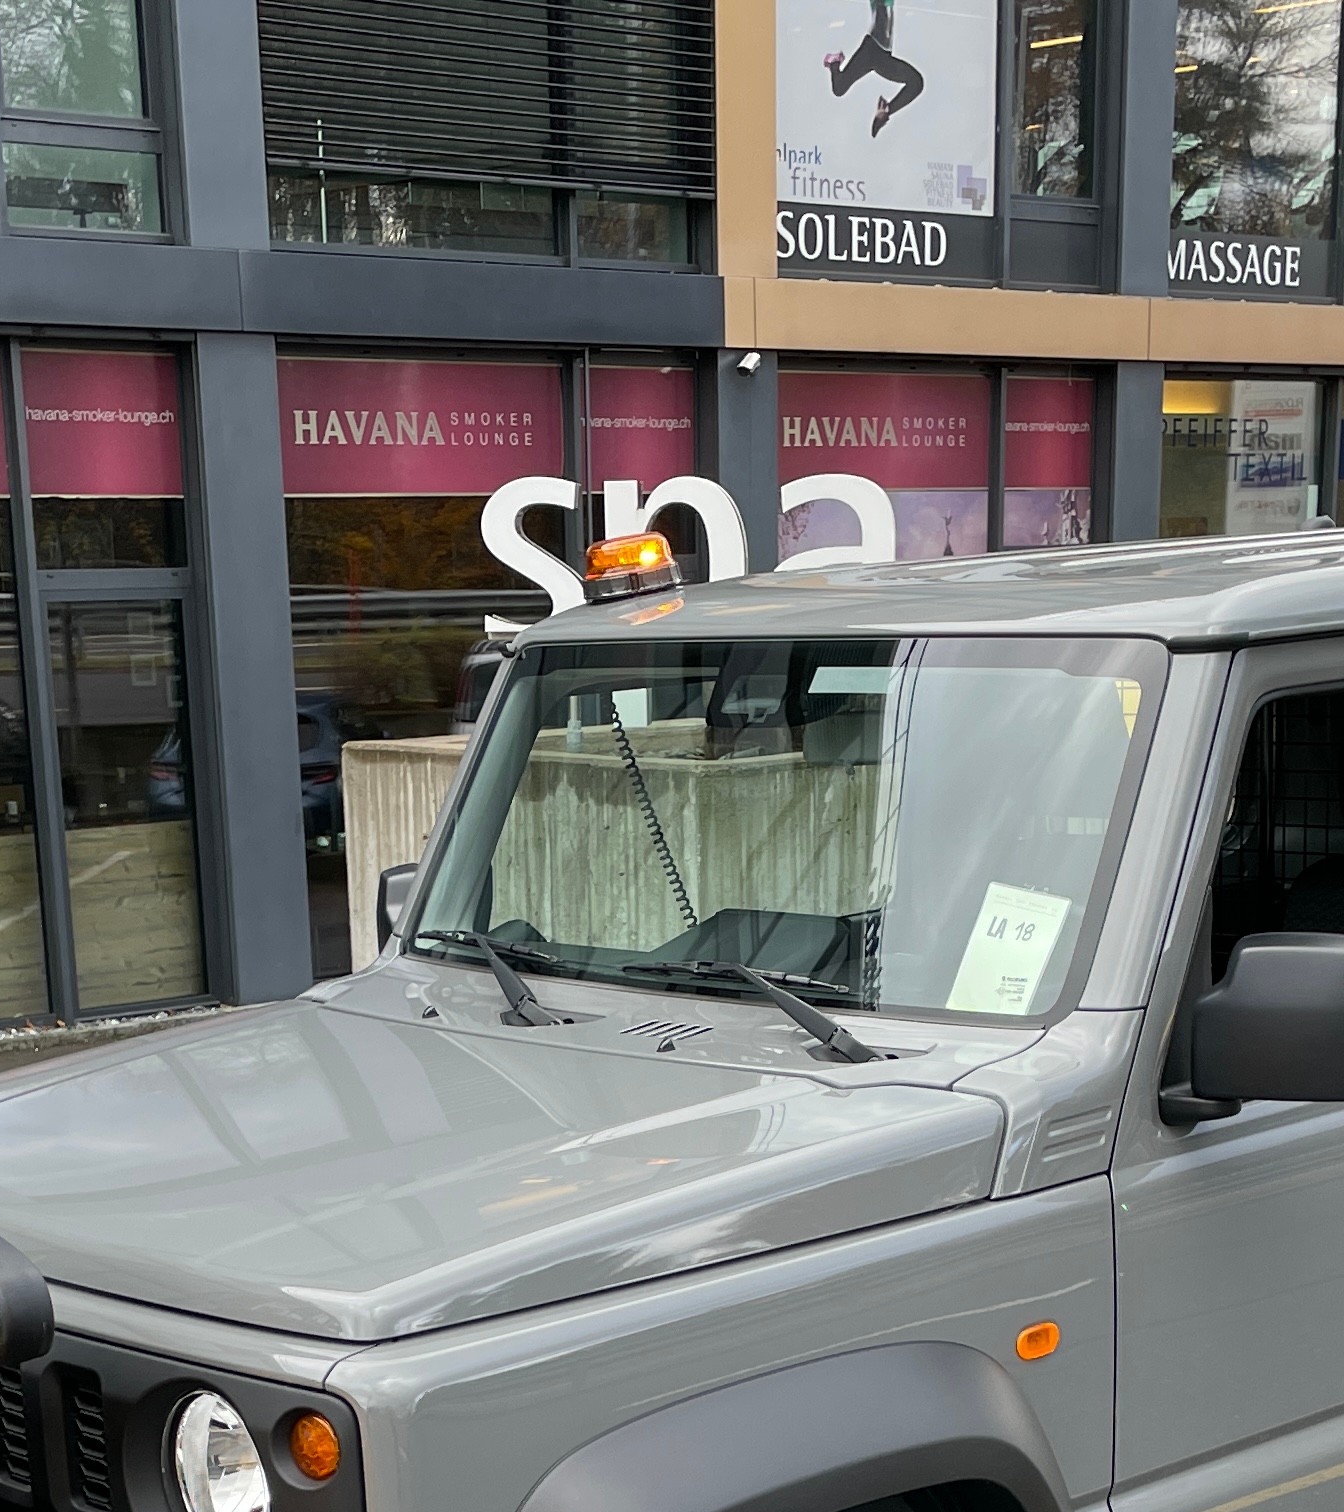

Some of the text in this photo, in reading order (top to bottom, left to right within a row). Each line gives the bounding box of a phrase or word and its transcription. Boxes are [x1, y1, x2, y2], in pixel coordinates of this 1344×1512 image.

[790, 166, 866, 202] fitness
[776, 210, 947, 267] SOLEBAD
[1167, 239, 1301, 287] MASSAGE
[25, 406, 175, 426] havana-smoker-lounge.ch
[292, 409, 534, 446] HAVANA SMOKER
[451, 431, 534, 446] LOUNGE
[782, 416, 967, 447] HAVANA SMOKER
[902, 433, 967, 447] LOUNGE
[1227, 452, 1307, 482] TEXTIL
[986, 915, 1036, 942] LA 18
